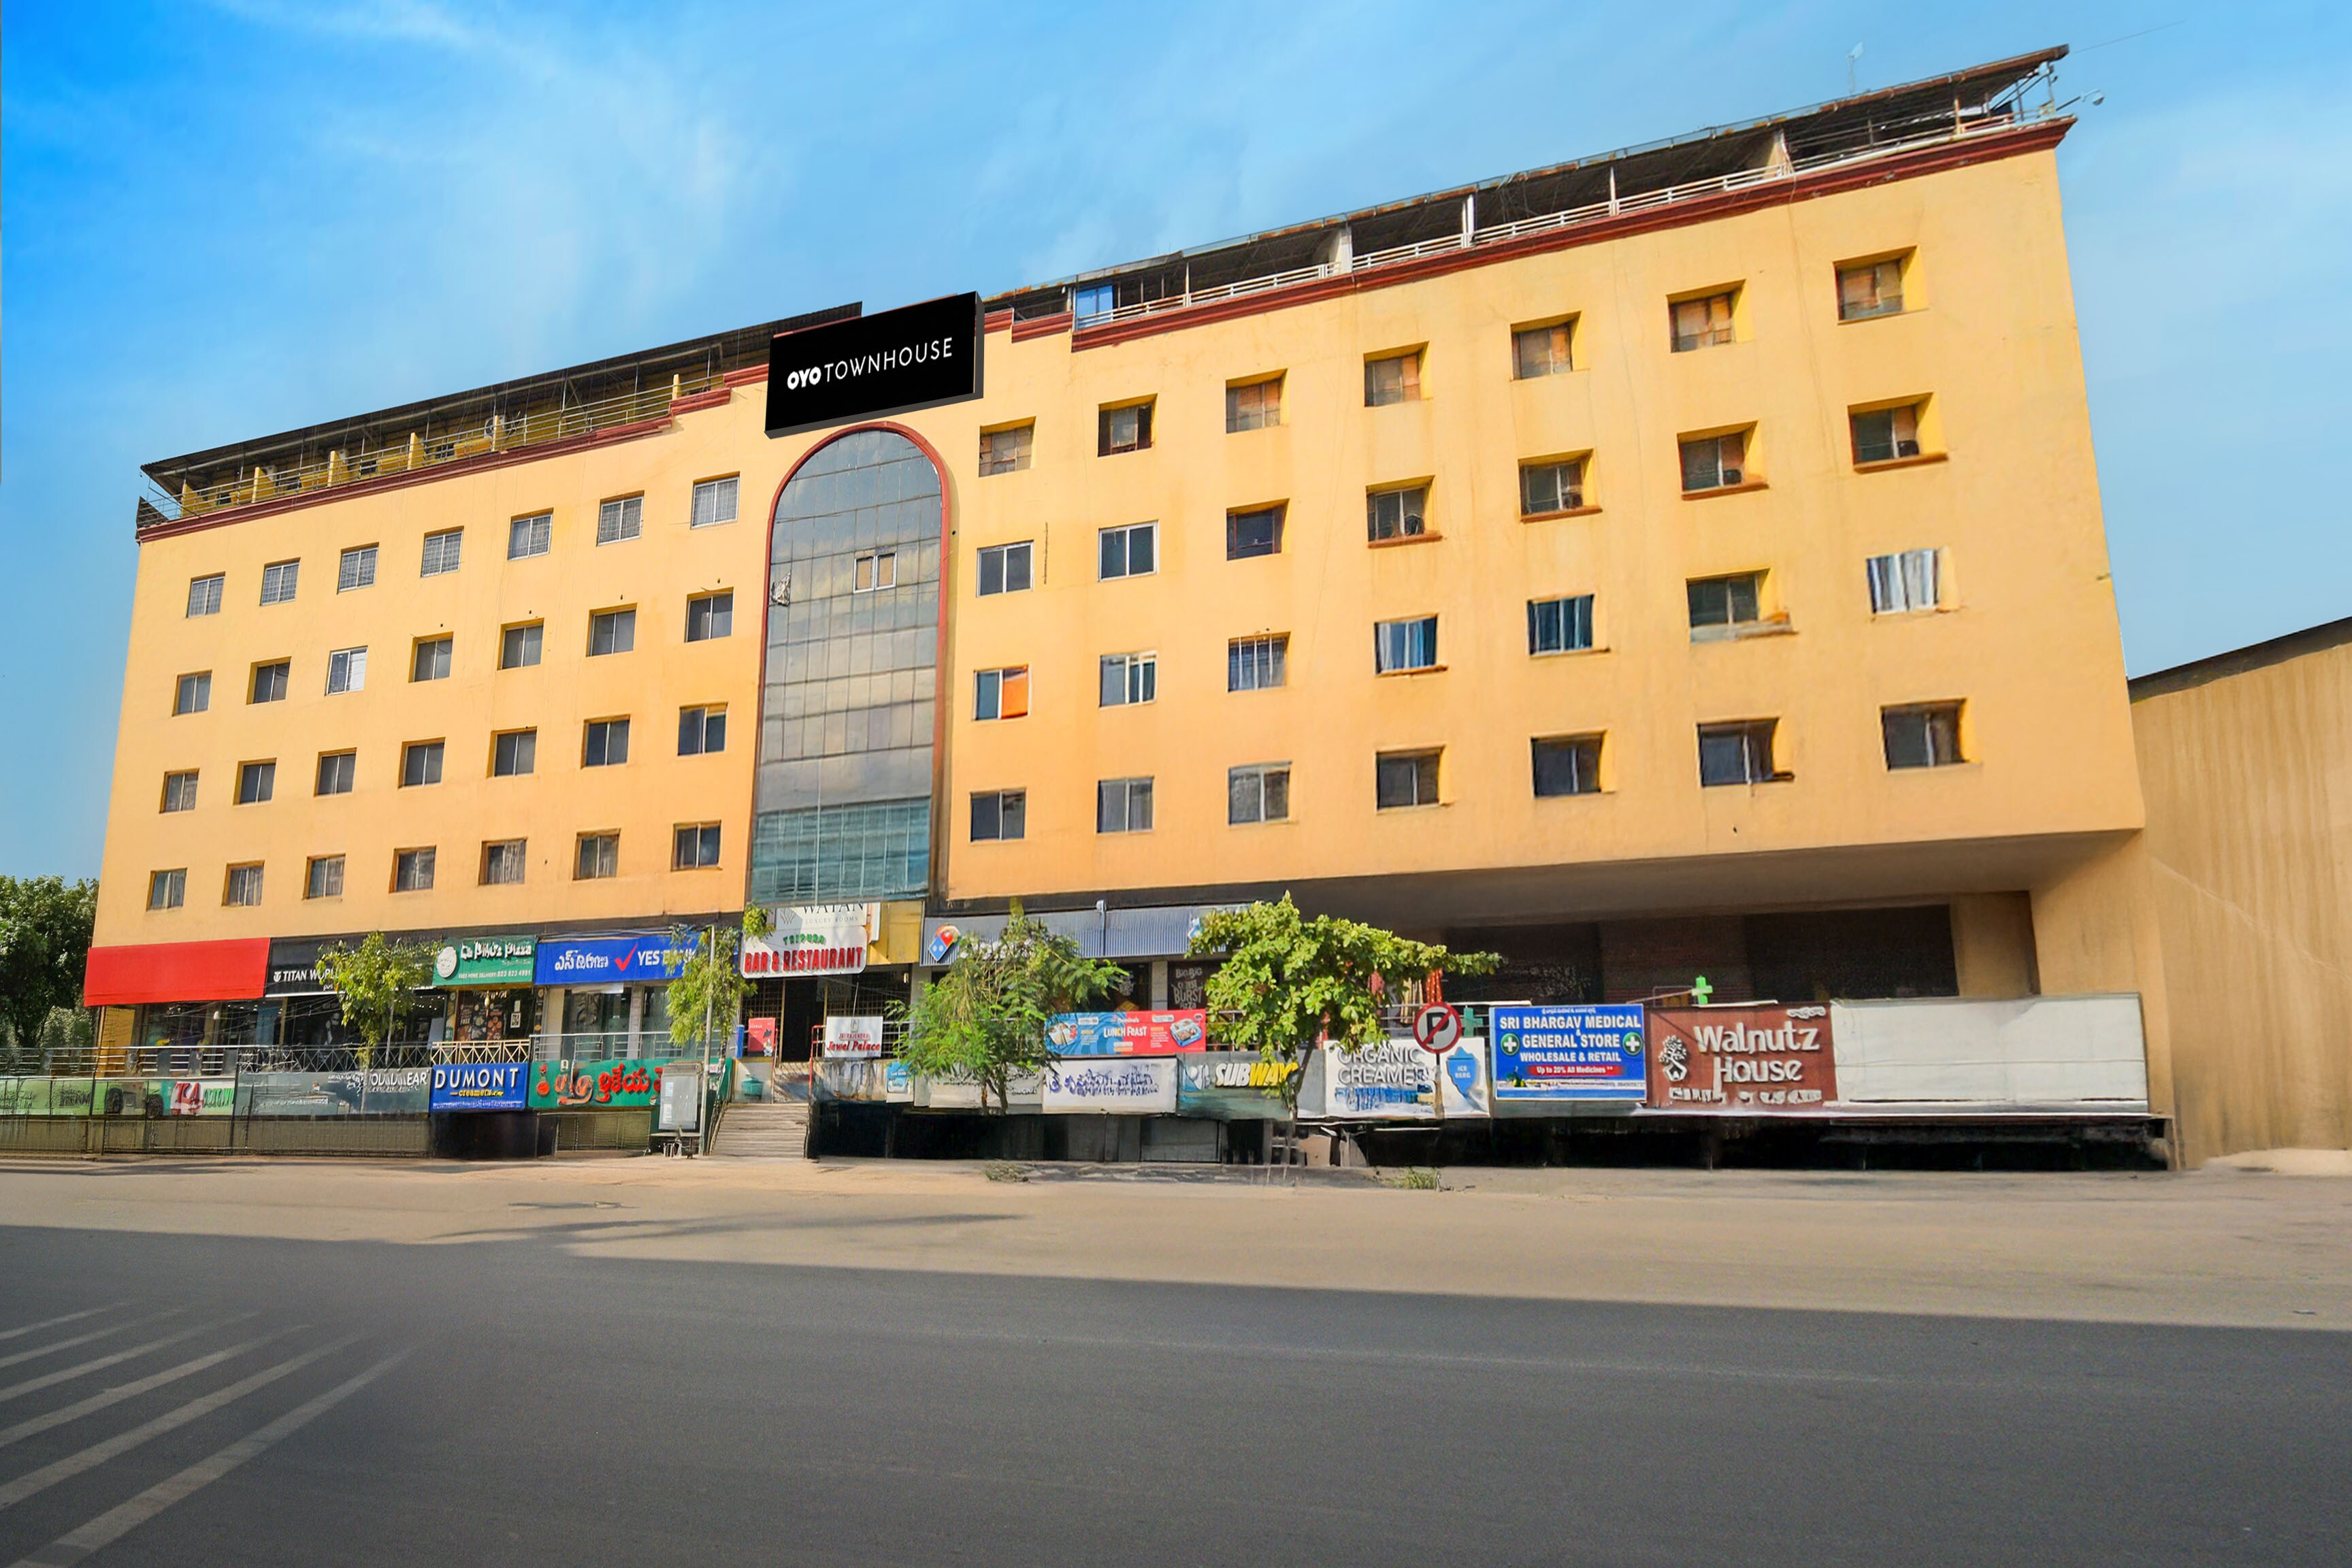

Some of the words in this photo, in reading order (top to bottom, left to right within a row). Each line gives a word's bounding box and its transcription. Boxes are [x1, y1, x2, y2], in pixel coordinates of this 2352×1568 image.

[787, 366, 821, 390] OYO
[824, 337, 953, 382] TOWNHOUSE
[638, 950, 660, 966] YES
[744, 951, 768, 973] BAR
[771, 951, 779, 972] &
[783, 947, 863, 971] RESTAURANT
[283, 970, 307, 981] TITAN
[1500, 1017, 1519, 1029] SRI
[1524, 1016, 1582, 1029] BHARGAV
[1586, 1015, 1641, 1028] MEDICAL
[1522, 1034, 1578, 1048] GENERAL
[1581, 1034, 1620, 1047] STORE
[1693, 1021, 1820, 1054] Walnutz
[827, 1041, 850, 1051] Jewel
[851, 1041, 880, 1051] Palace
[1520, 1052, 1576, 1062] WHOLESALE
[1579, 1052, 1586, 1062] &
[1588, 1052, 1622, 1062] RETAIL
[1215, 1062, 1298, 1087] SUBWAY
[1537, 1066, 1543, 1075] Up
[1714, 1056, 1803, 1083] House
[435, 1068, 519, 1089] DUMONT
